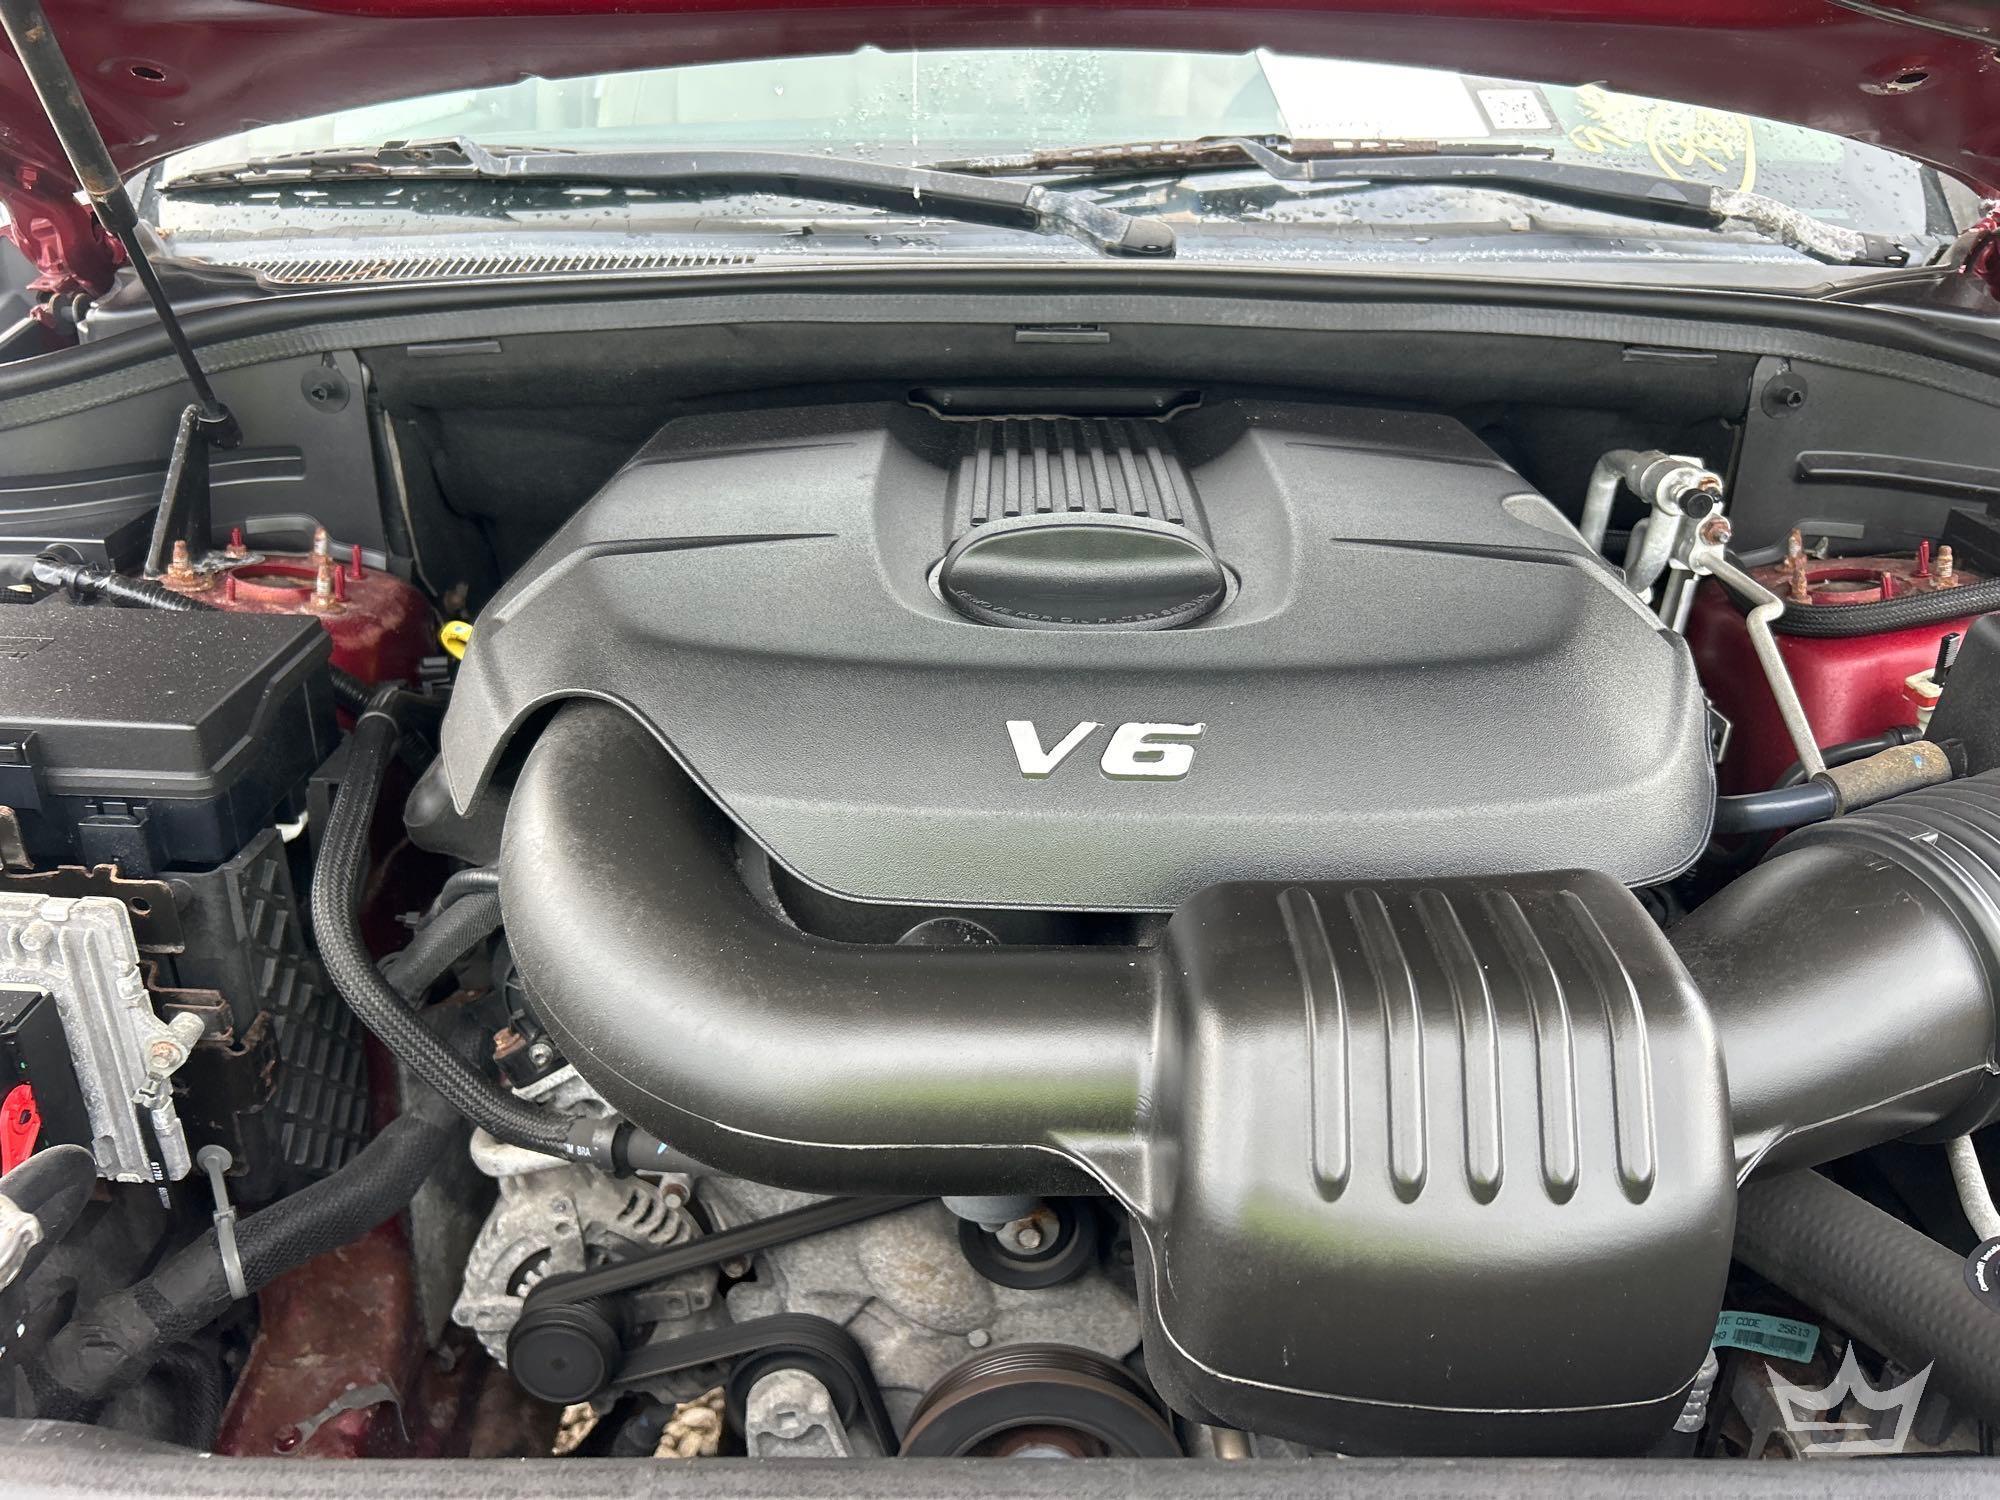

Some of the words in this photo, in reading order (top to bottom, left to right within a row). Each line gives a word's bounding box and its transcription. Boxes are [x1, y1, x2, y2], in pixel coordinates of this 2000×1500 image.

[1016, 611, 1053, 621] FOR
[1005, 720, 1207, 783] V6
[1735, 1316, 1761, 1328] CODE
